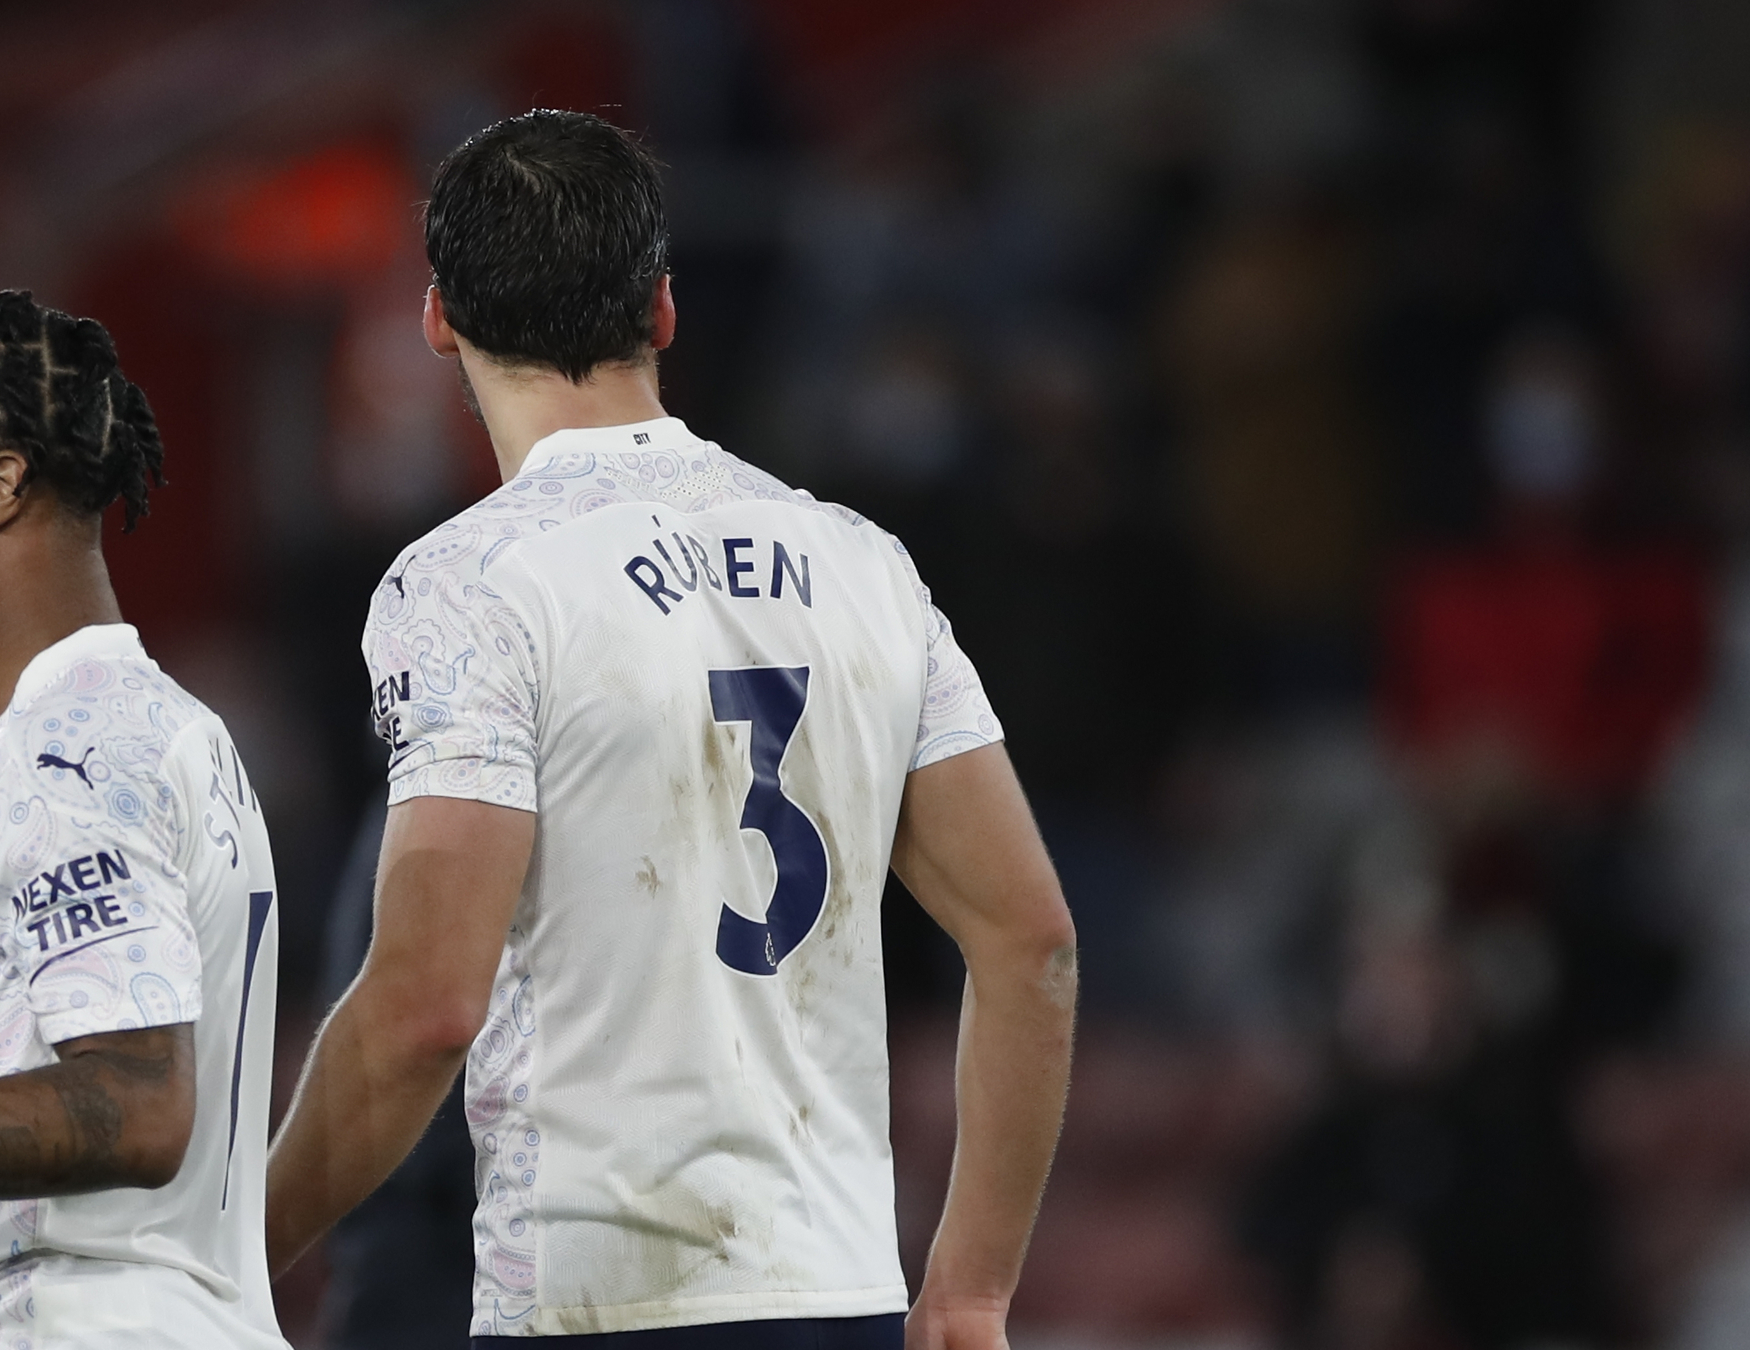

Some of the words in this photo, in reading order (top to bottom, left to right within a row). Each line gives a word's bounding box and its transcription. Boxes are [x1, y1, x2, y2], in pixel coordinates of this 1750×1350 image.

[623, 514, 813, 617] RÚBEN
[708, 666, 829, 977] 3
[11, 849, 132, 926] NEXEN
[27, 895, 128, 952] TIRE
